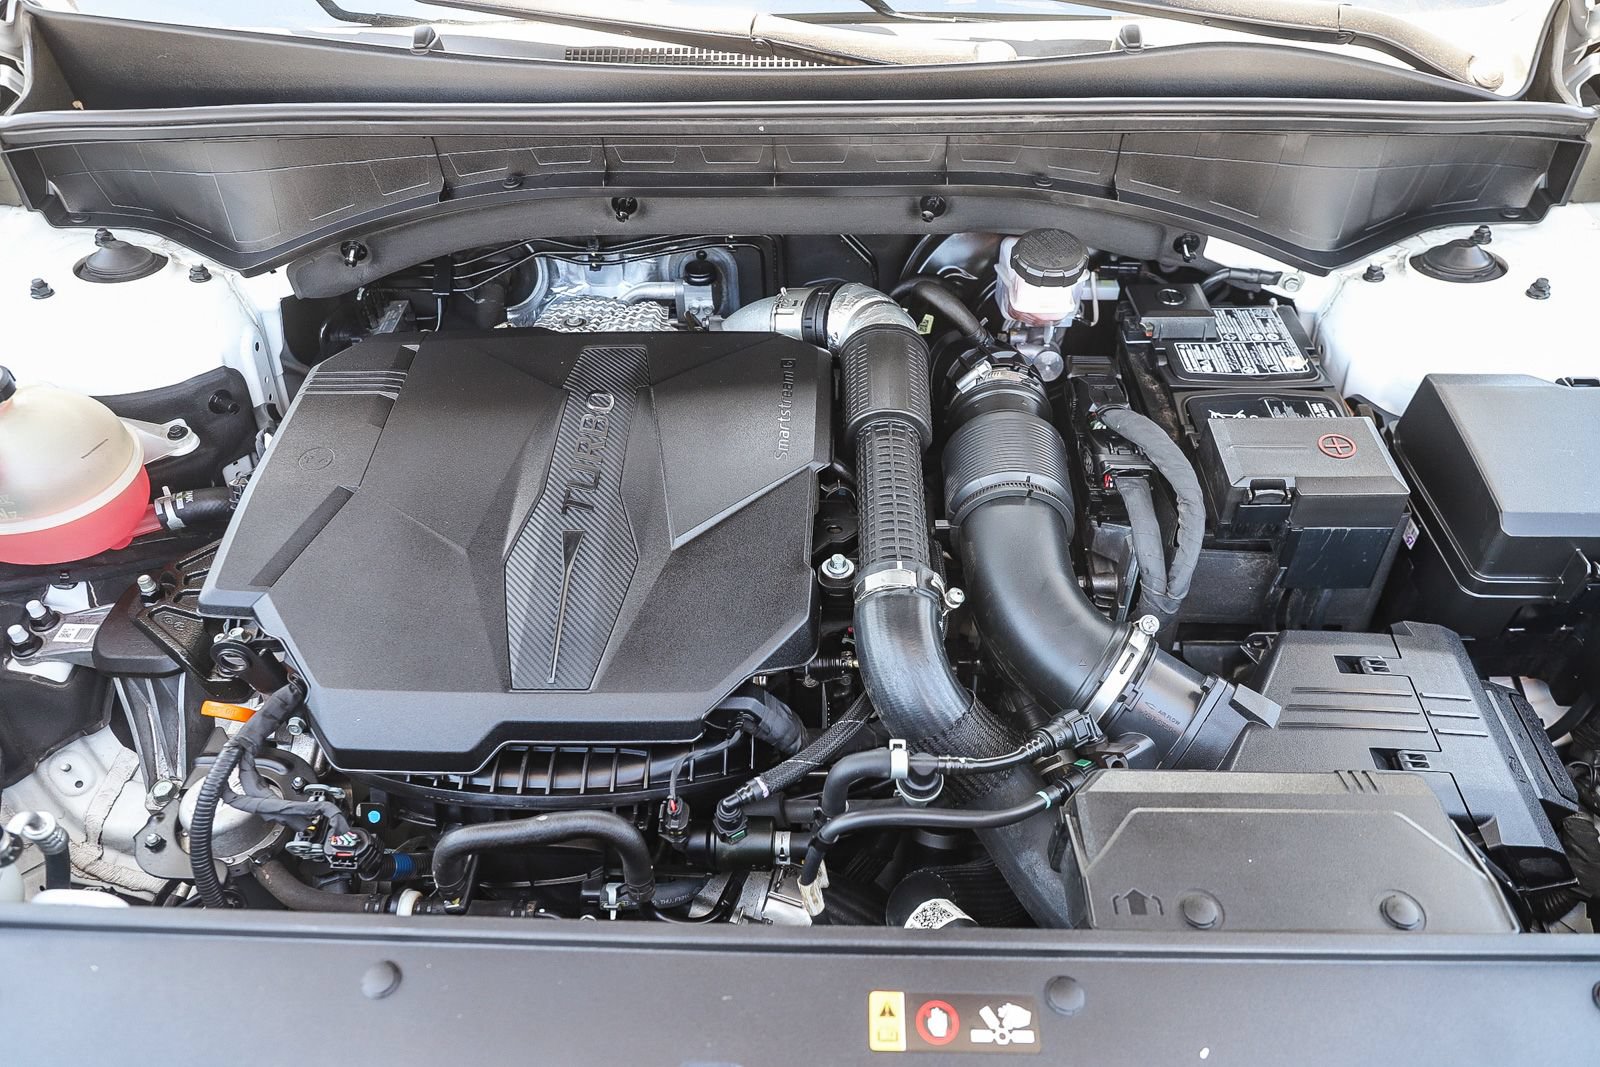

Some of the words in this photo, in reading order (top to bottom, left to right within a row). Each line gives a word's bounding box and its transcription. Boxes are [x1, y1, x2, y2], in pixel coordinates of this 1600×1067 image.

[562, 390, 615, 515] TURBO
[774, 371, 794, 460] Smartstream
[1167, 714, 1181, 726] FLOW
